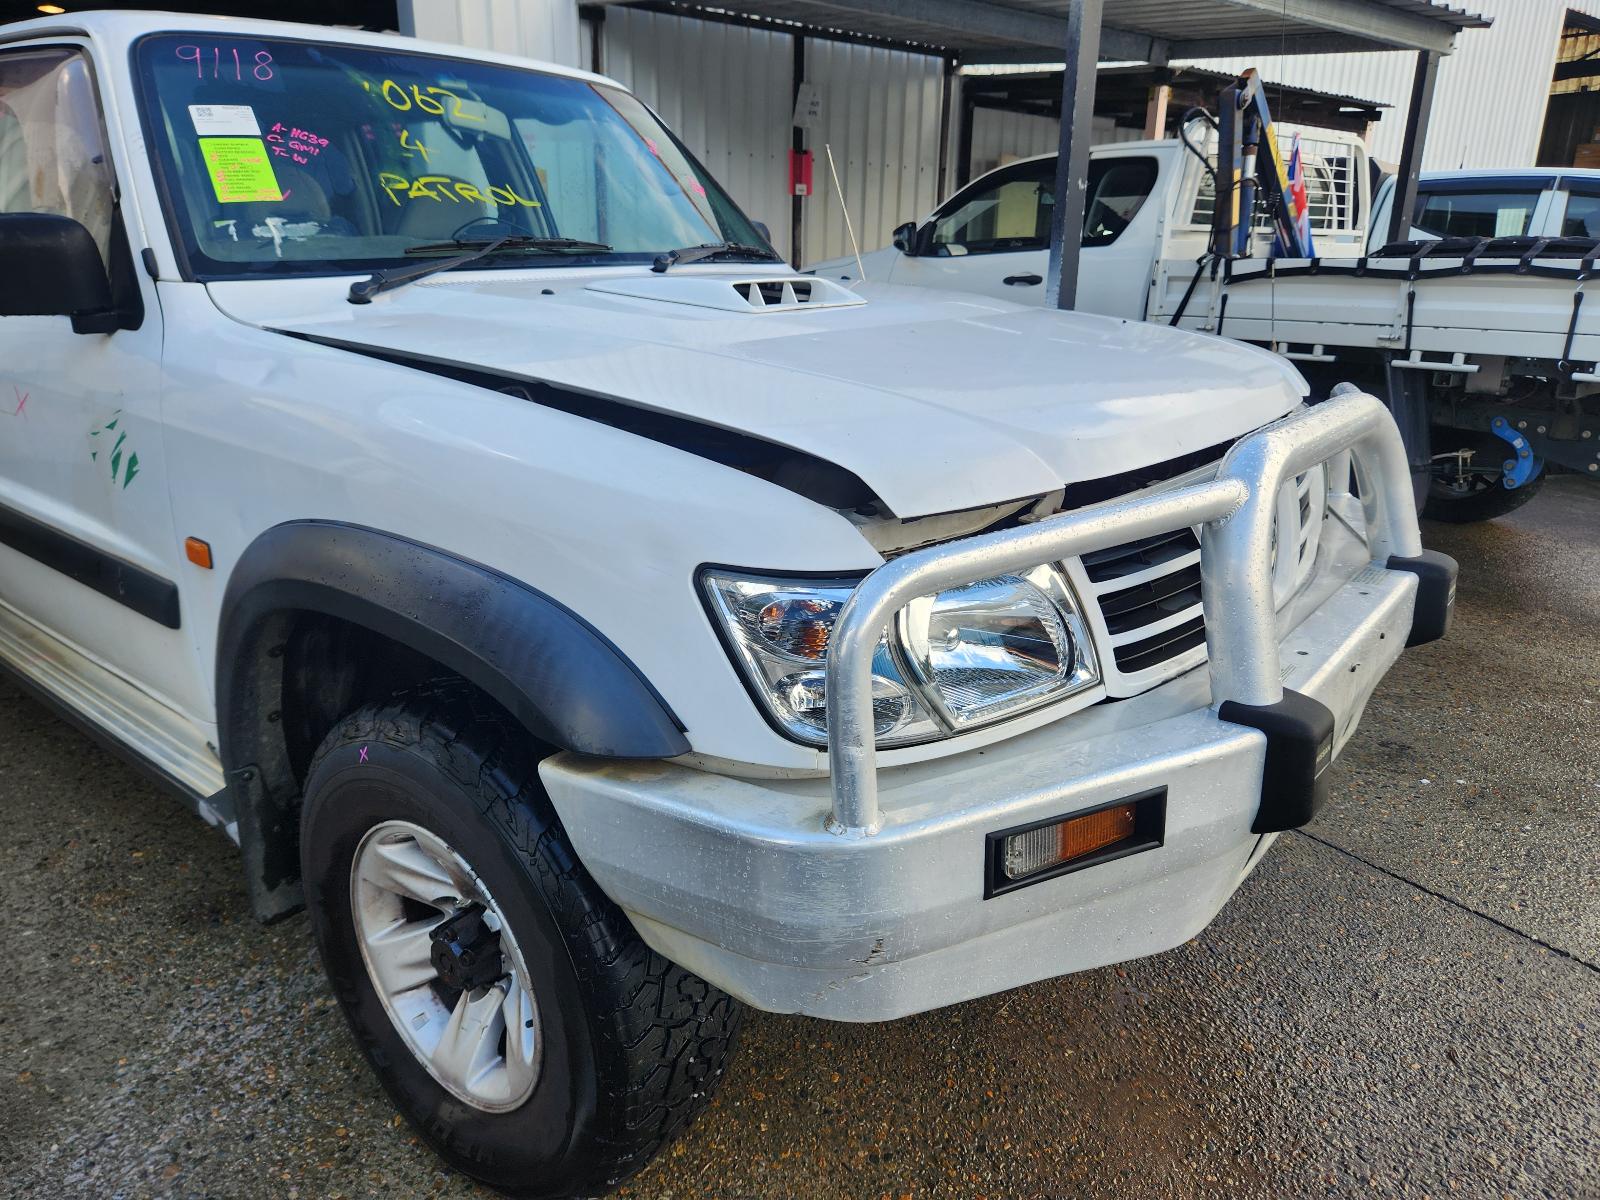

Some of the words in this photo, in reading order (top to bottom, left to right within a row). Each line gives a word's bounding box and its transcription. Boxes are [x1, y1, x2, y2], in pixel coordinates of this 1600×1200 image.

[175, 45, 273, 81] 9118
[400, 129, 432, 164] 4
[379, 172, 542, 207] PATROL
